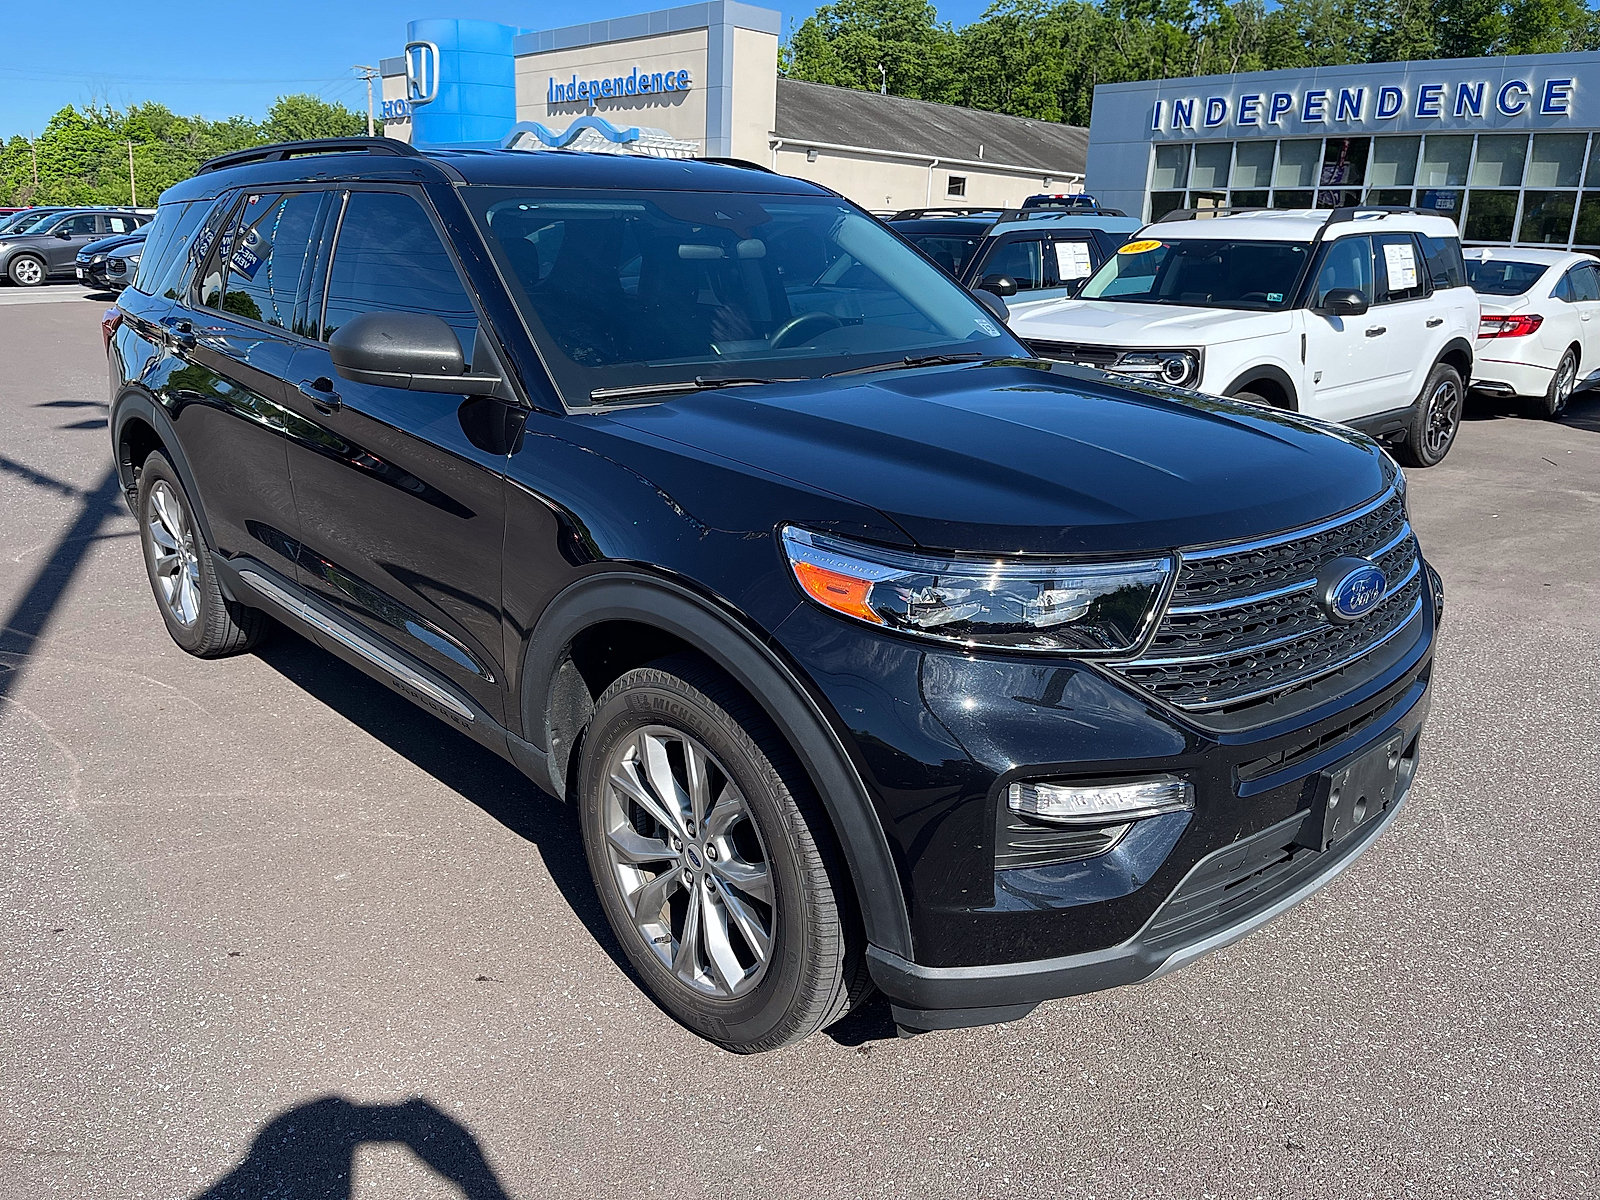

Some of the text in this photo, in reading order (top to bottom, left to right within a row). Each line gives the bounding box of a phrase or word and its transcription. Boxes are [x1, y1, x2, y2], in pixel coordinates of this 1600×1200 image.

[549, 67, 690, 107] Independence
[1152, 78, 1574, 131] INDEPENDENCE
[1347, 577, 1380, 610] Ford
[653, 697, 731, 750] MICHELIN
